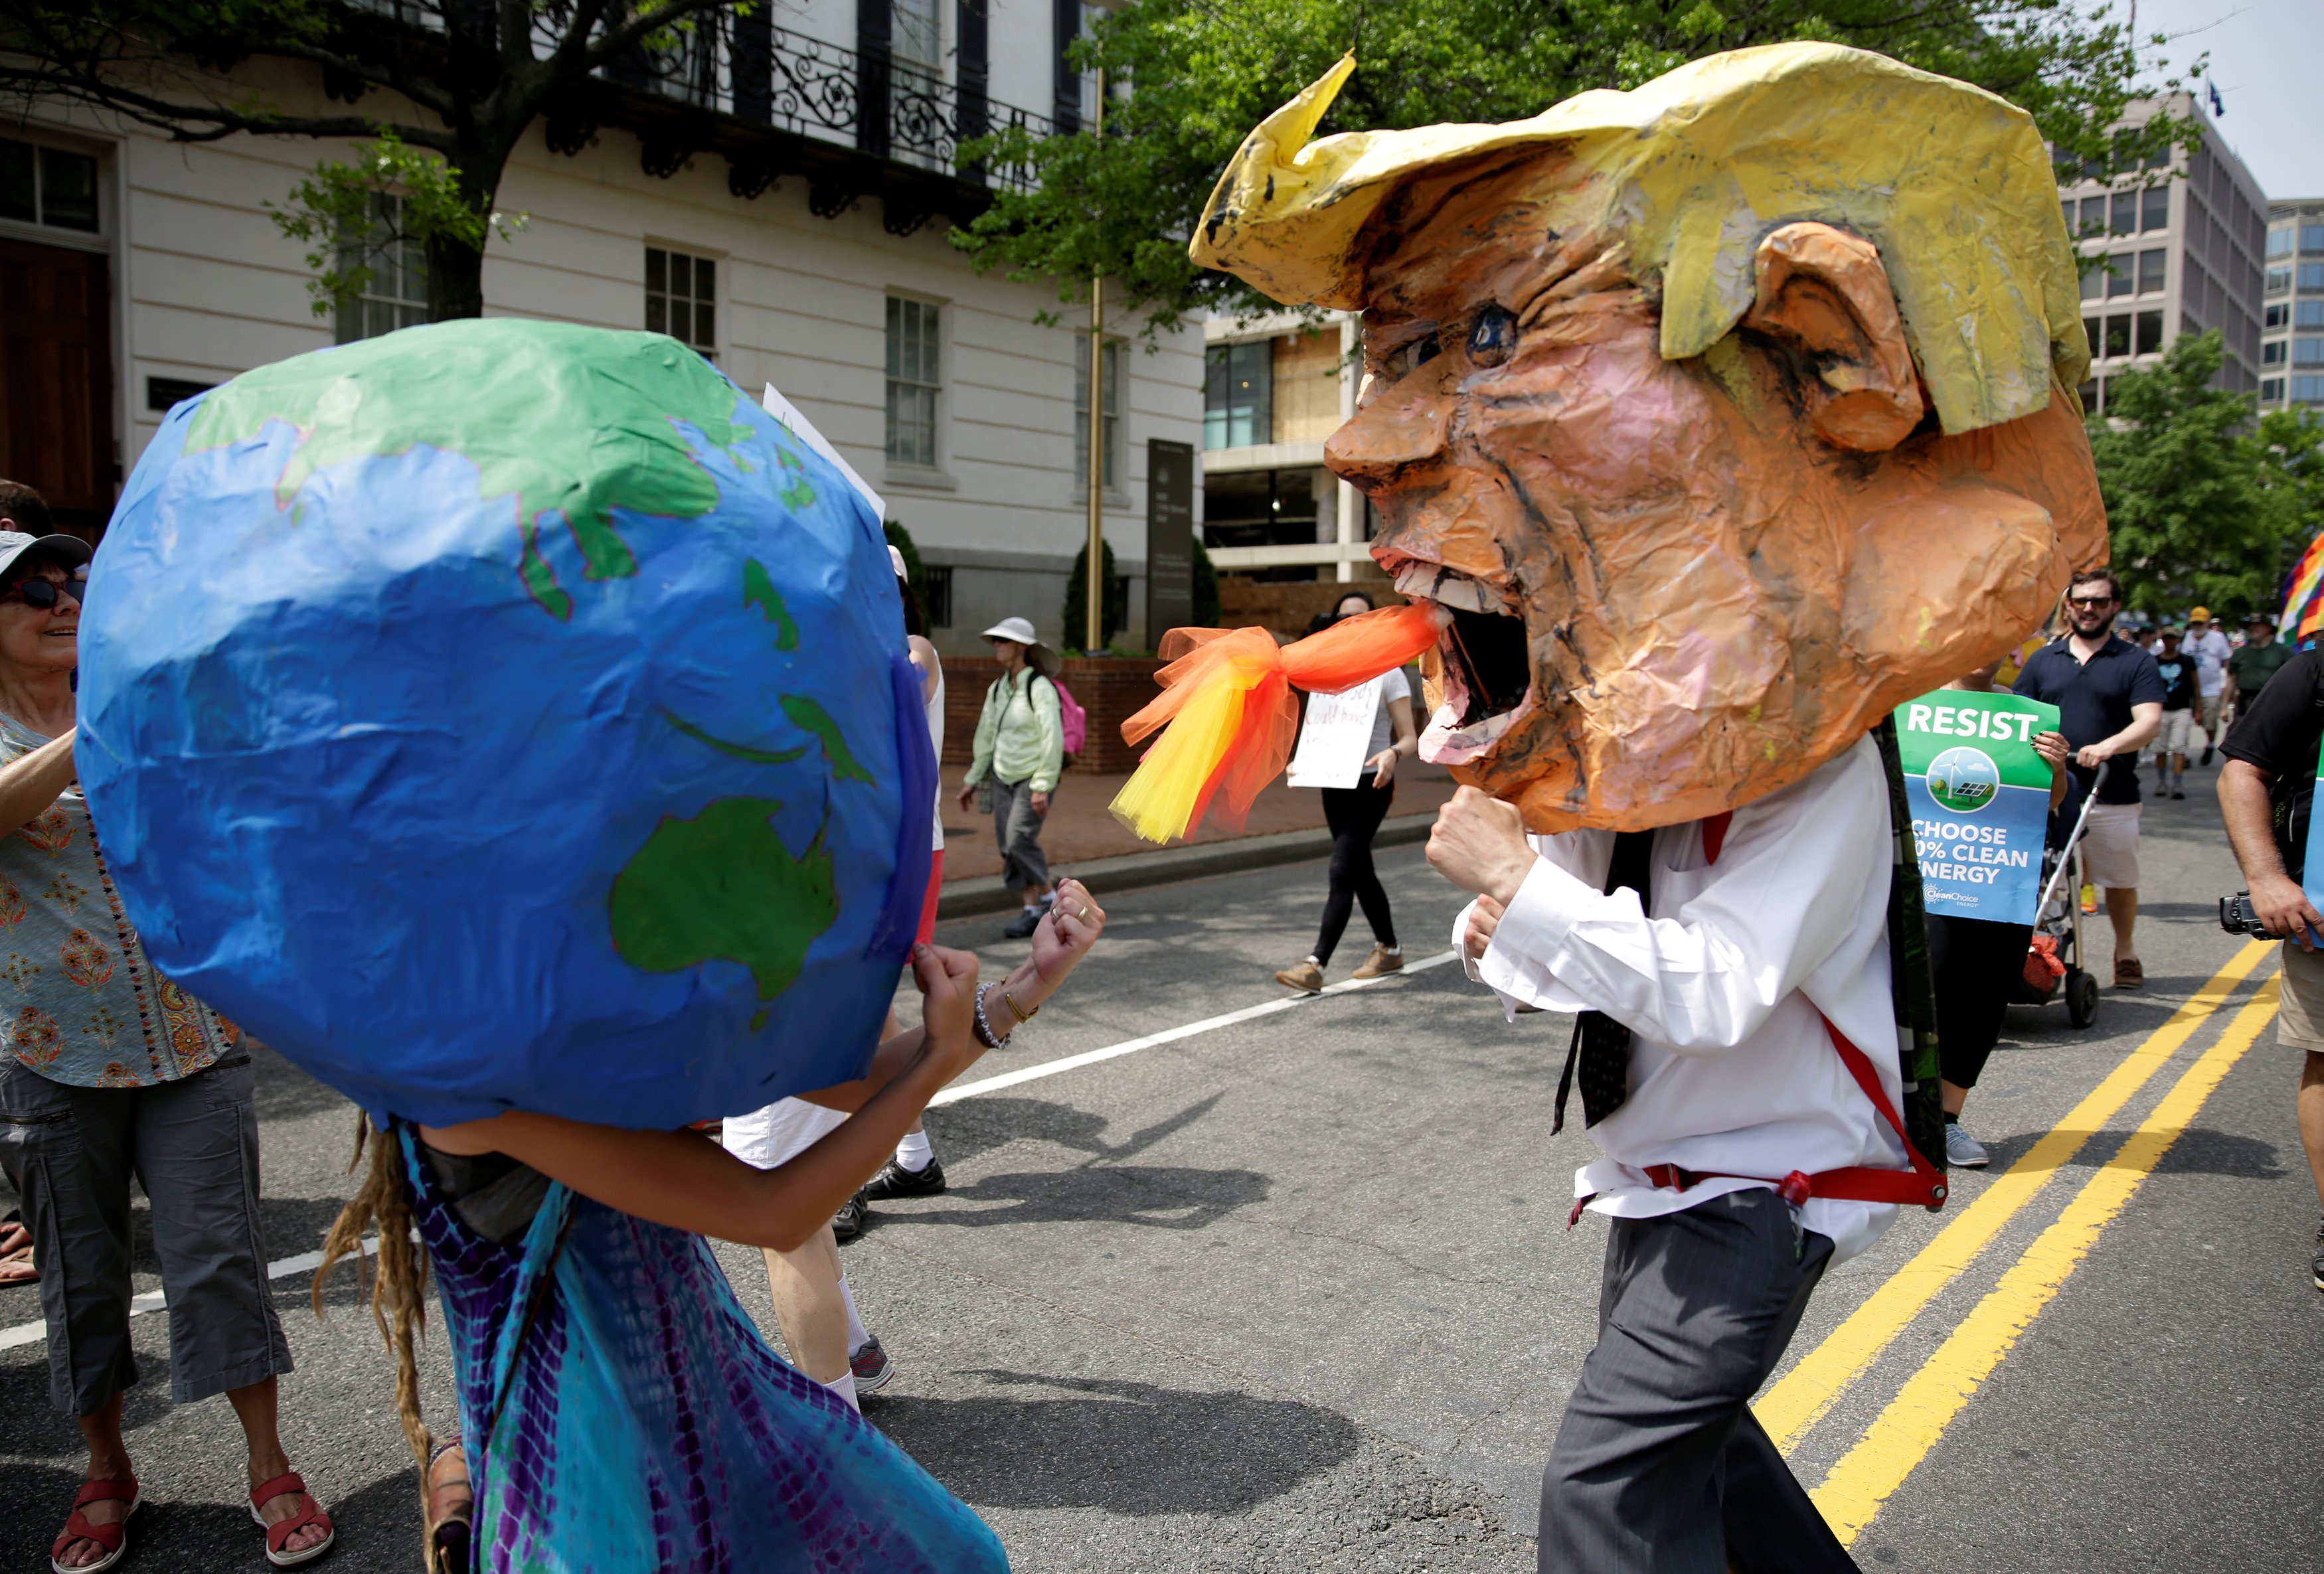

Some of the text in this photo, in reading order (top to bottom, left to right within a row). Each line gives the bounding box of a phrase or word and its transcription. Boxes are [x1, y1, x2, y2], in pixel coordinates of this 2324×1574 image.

[1315, 682, 1372, 708] ody
[1907, 704, 2038, 742] RESIST
[1911, 819, 2007, 845] CHOOSE
[1952, 844, 2029, 867] CLEAN
[1927, 890, 1979, 902] CleanChoice
